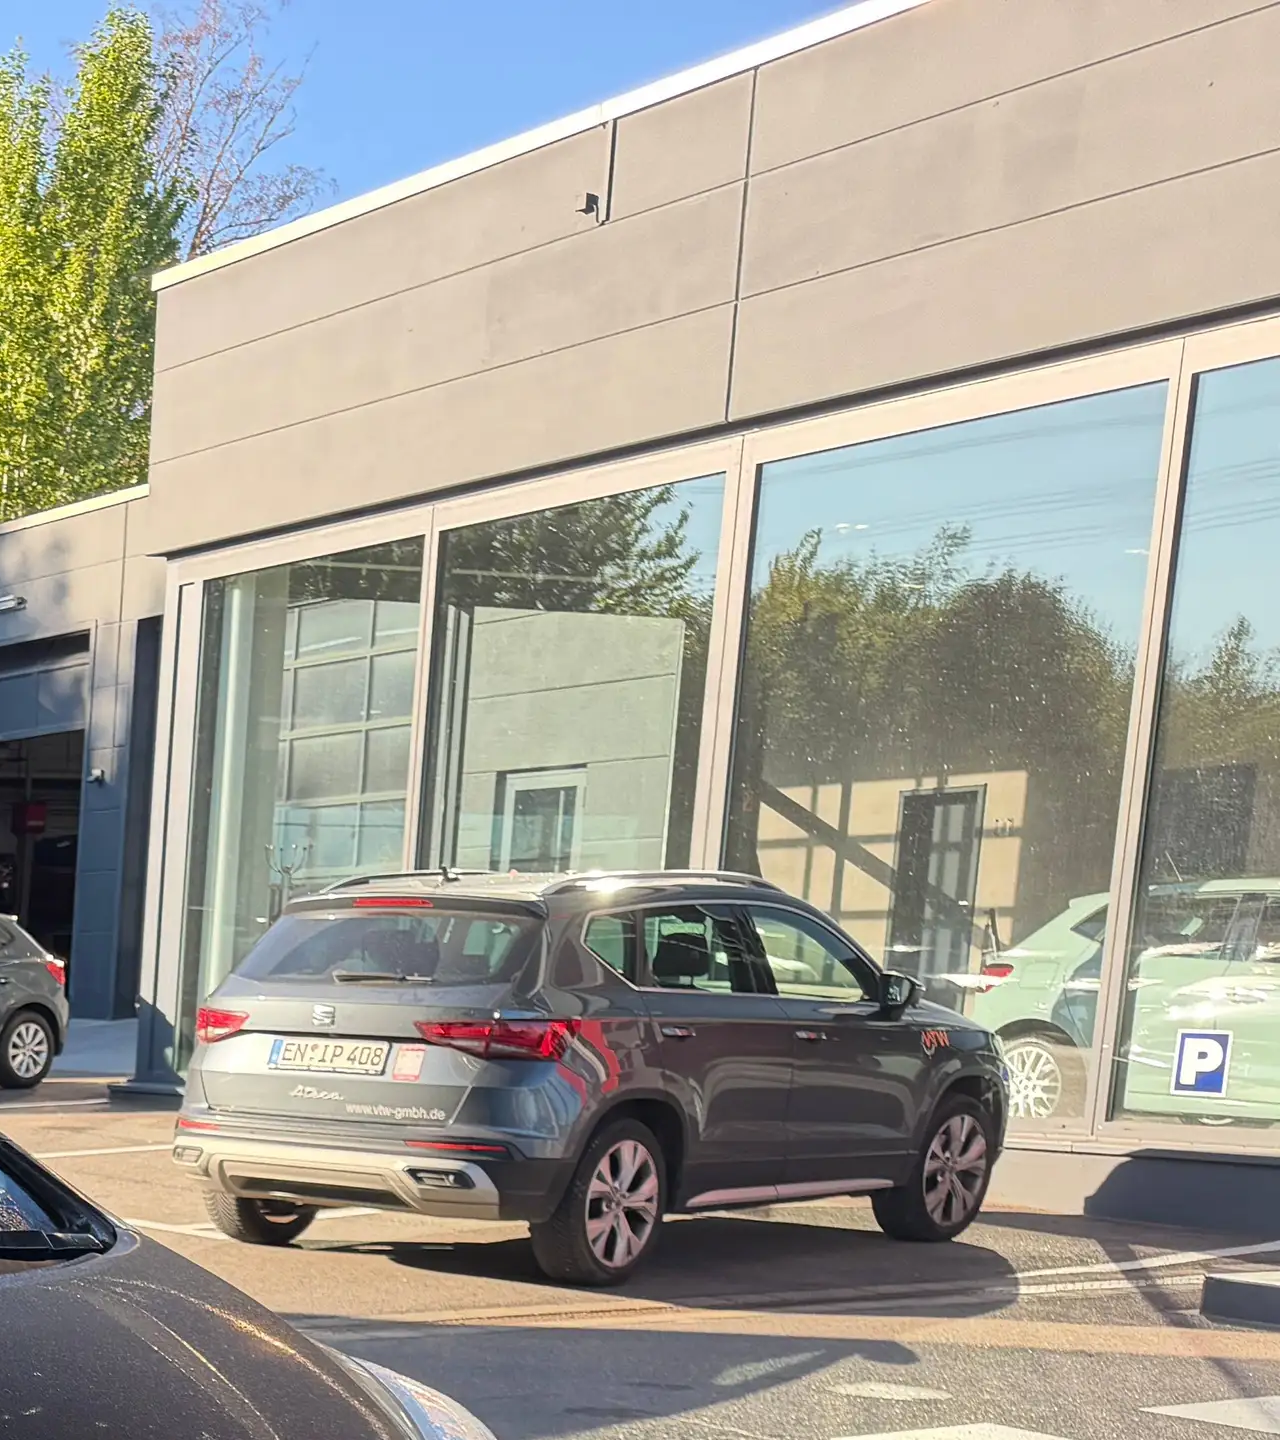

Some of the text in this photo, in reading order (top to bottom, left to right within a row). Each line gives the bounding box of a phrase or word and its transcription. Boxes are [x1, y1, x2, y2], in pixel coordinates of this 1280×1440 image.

[281, 1042, 307, 1063] EN
[318, 1044, 344, 1064] IP
[346, 1046, 384, 1067] 408
[1179, 1037, 1224, 1085] P
